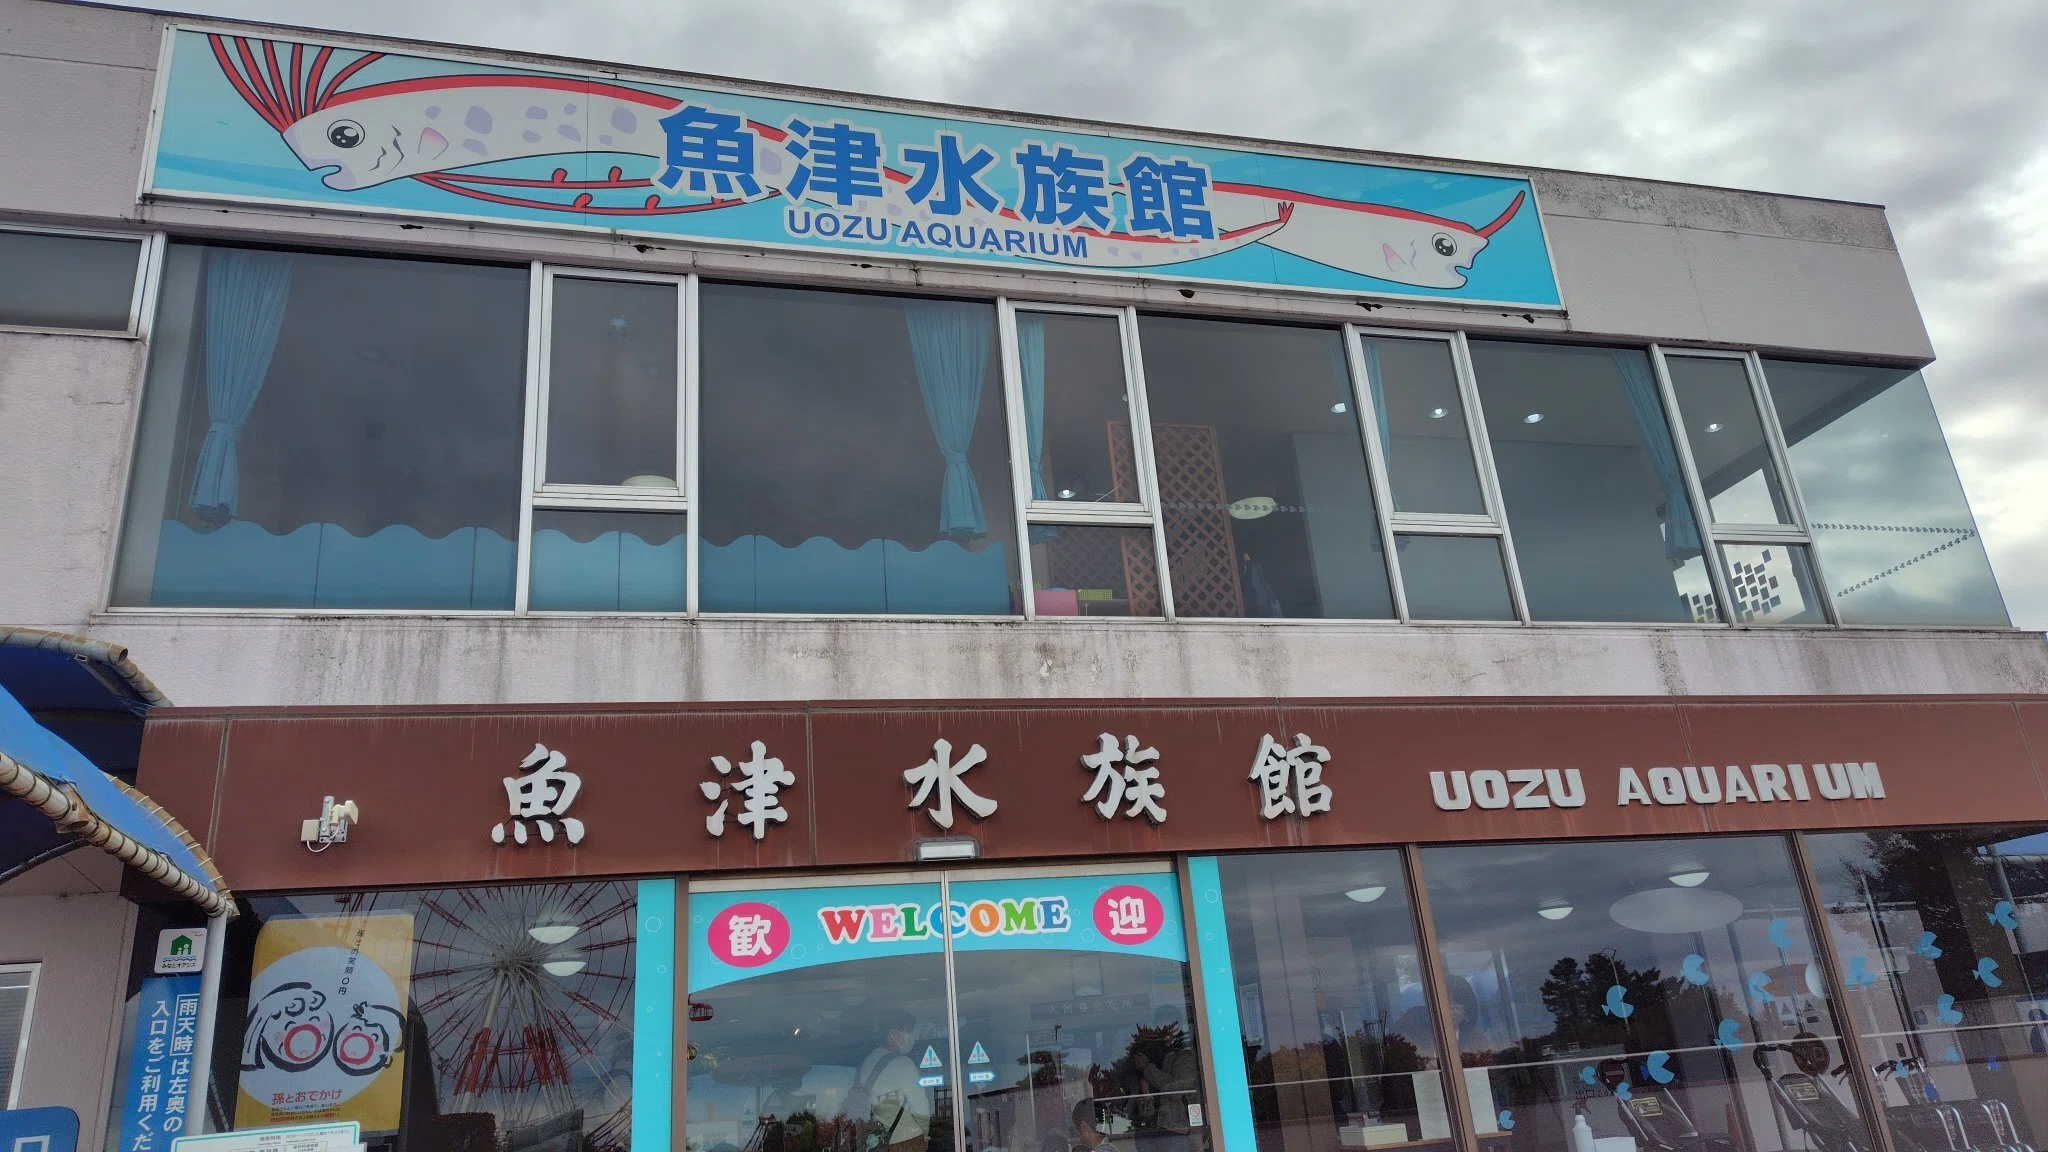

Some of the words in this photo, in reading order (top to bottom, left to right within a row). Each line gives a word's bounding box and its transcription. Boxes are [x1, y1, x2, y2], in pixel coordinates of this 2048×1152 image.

[657, 104, 1215, 240] 魚津水族館
[787, 208, 889, 241] UOZU
[901, 219, 1089, 259] AQUARIUM
[490, 731, 1333, 847] 魚津水族館
[1429, 767, 1587, 811] UOZU
[1617, 761, 1887, 806] AQUARIUM
[728, 914, 772, 958] 歓
[819, 896, 1070, 944] WELCOME
[1107, 894, 1148, 937] 迎
[132, 1000, 171, 1152] 入口をご利用くだ
[163, 998, 199, 1133] 雨天時は左奥の
[271, 1088, 343, 1106] 孫とおでかけ
